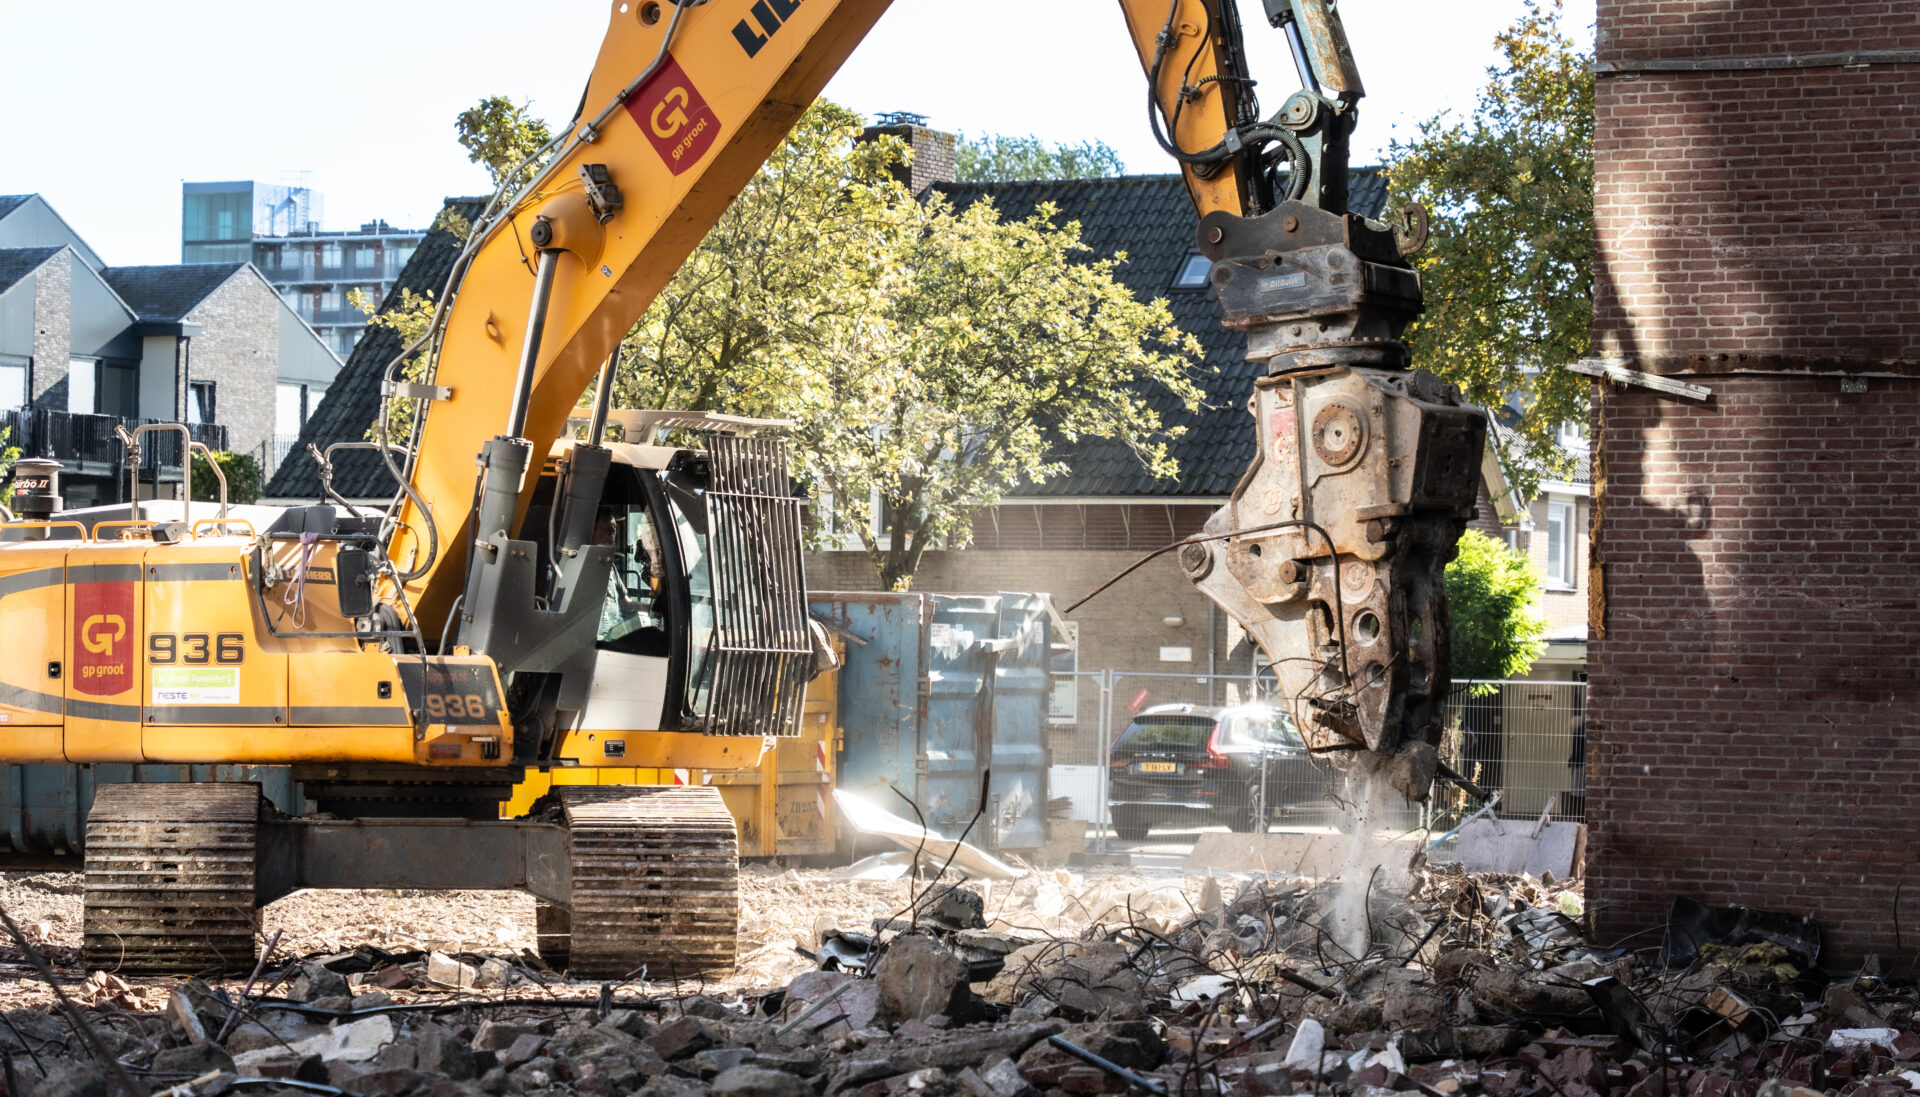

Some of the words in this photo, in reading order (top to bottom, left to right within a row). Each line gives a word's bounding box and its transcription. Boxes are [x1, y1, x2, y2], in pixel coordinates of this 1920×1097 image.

[672, 144, 684, 161] gp
[683, 117, 708, 149] groot
[148, 632, 245, 666] 936
[82, 665, 95, 678] gp
[96, 663, 124, 678] groot
[426, 693, 486, 718] 936
